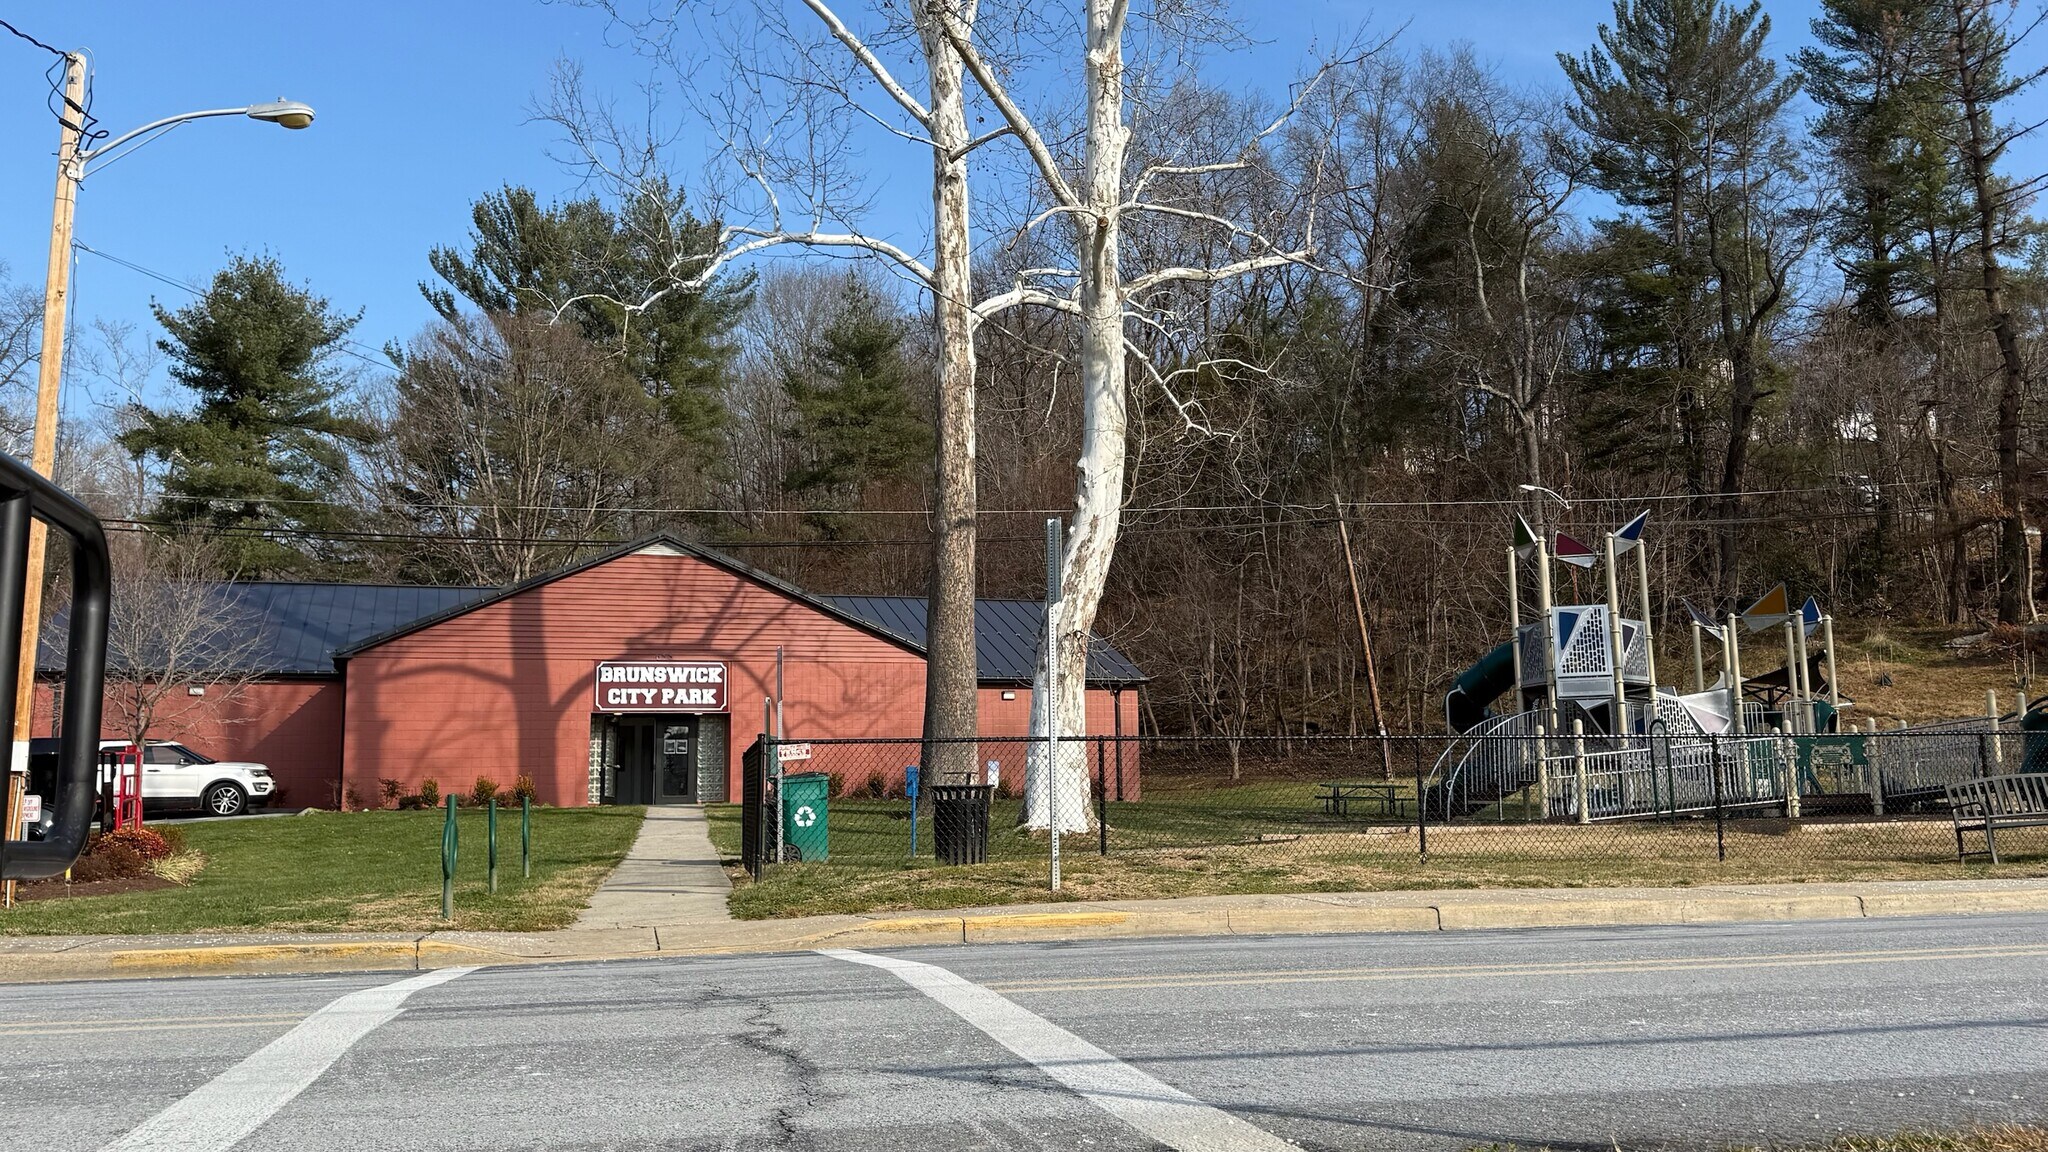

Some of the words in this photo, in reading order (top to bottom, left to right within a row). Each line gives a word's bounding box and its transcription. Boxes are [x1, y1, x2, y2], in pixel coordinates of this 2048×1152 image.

[600, 666, 723, 683] BRUNSWICK
[607, 688, 658, 705] CITY
[661, 688, 717, 705] PARK
